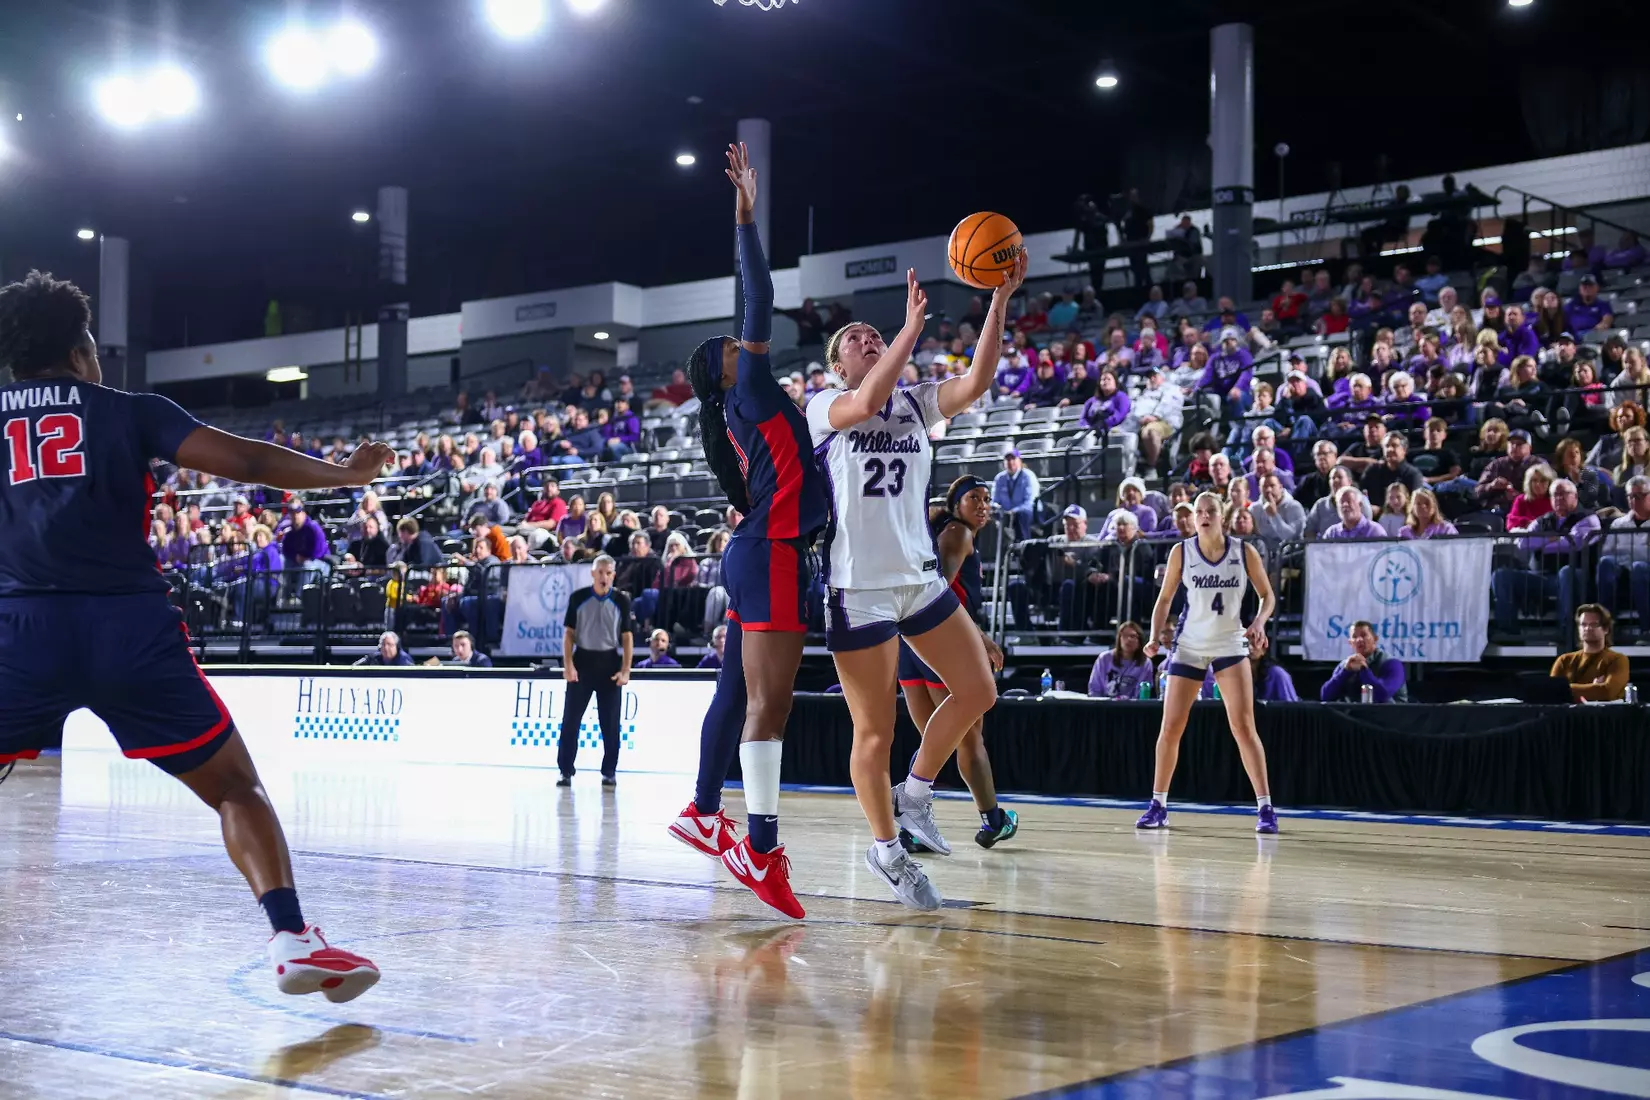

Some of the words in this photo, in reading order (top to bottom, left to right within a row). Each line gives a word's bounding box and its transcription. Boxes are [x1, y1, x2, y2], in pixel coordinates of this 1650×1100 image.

[848, 259, 895, 276] WOMEN
[2, 385, 82, 412] IWUALA
[3, 412, 86, 486] 12
[849, 429, 921, 453] Wildcats
[863, 457, 908, 497] 23
[1192, 574, 1240, 588] Wildcats
[1211, 592, 1224, 616] 4
[517, 620, 563, 640] South
[535, 642, 562, 653] BAN
[297, 677, 403, 715] HILLYARD
